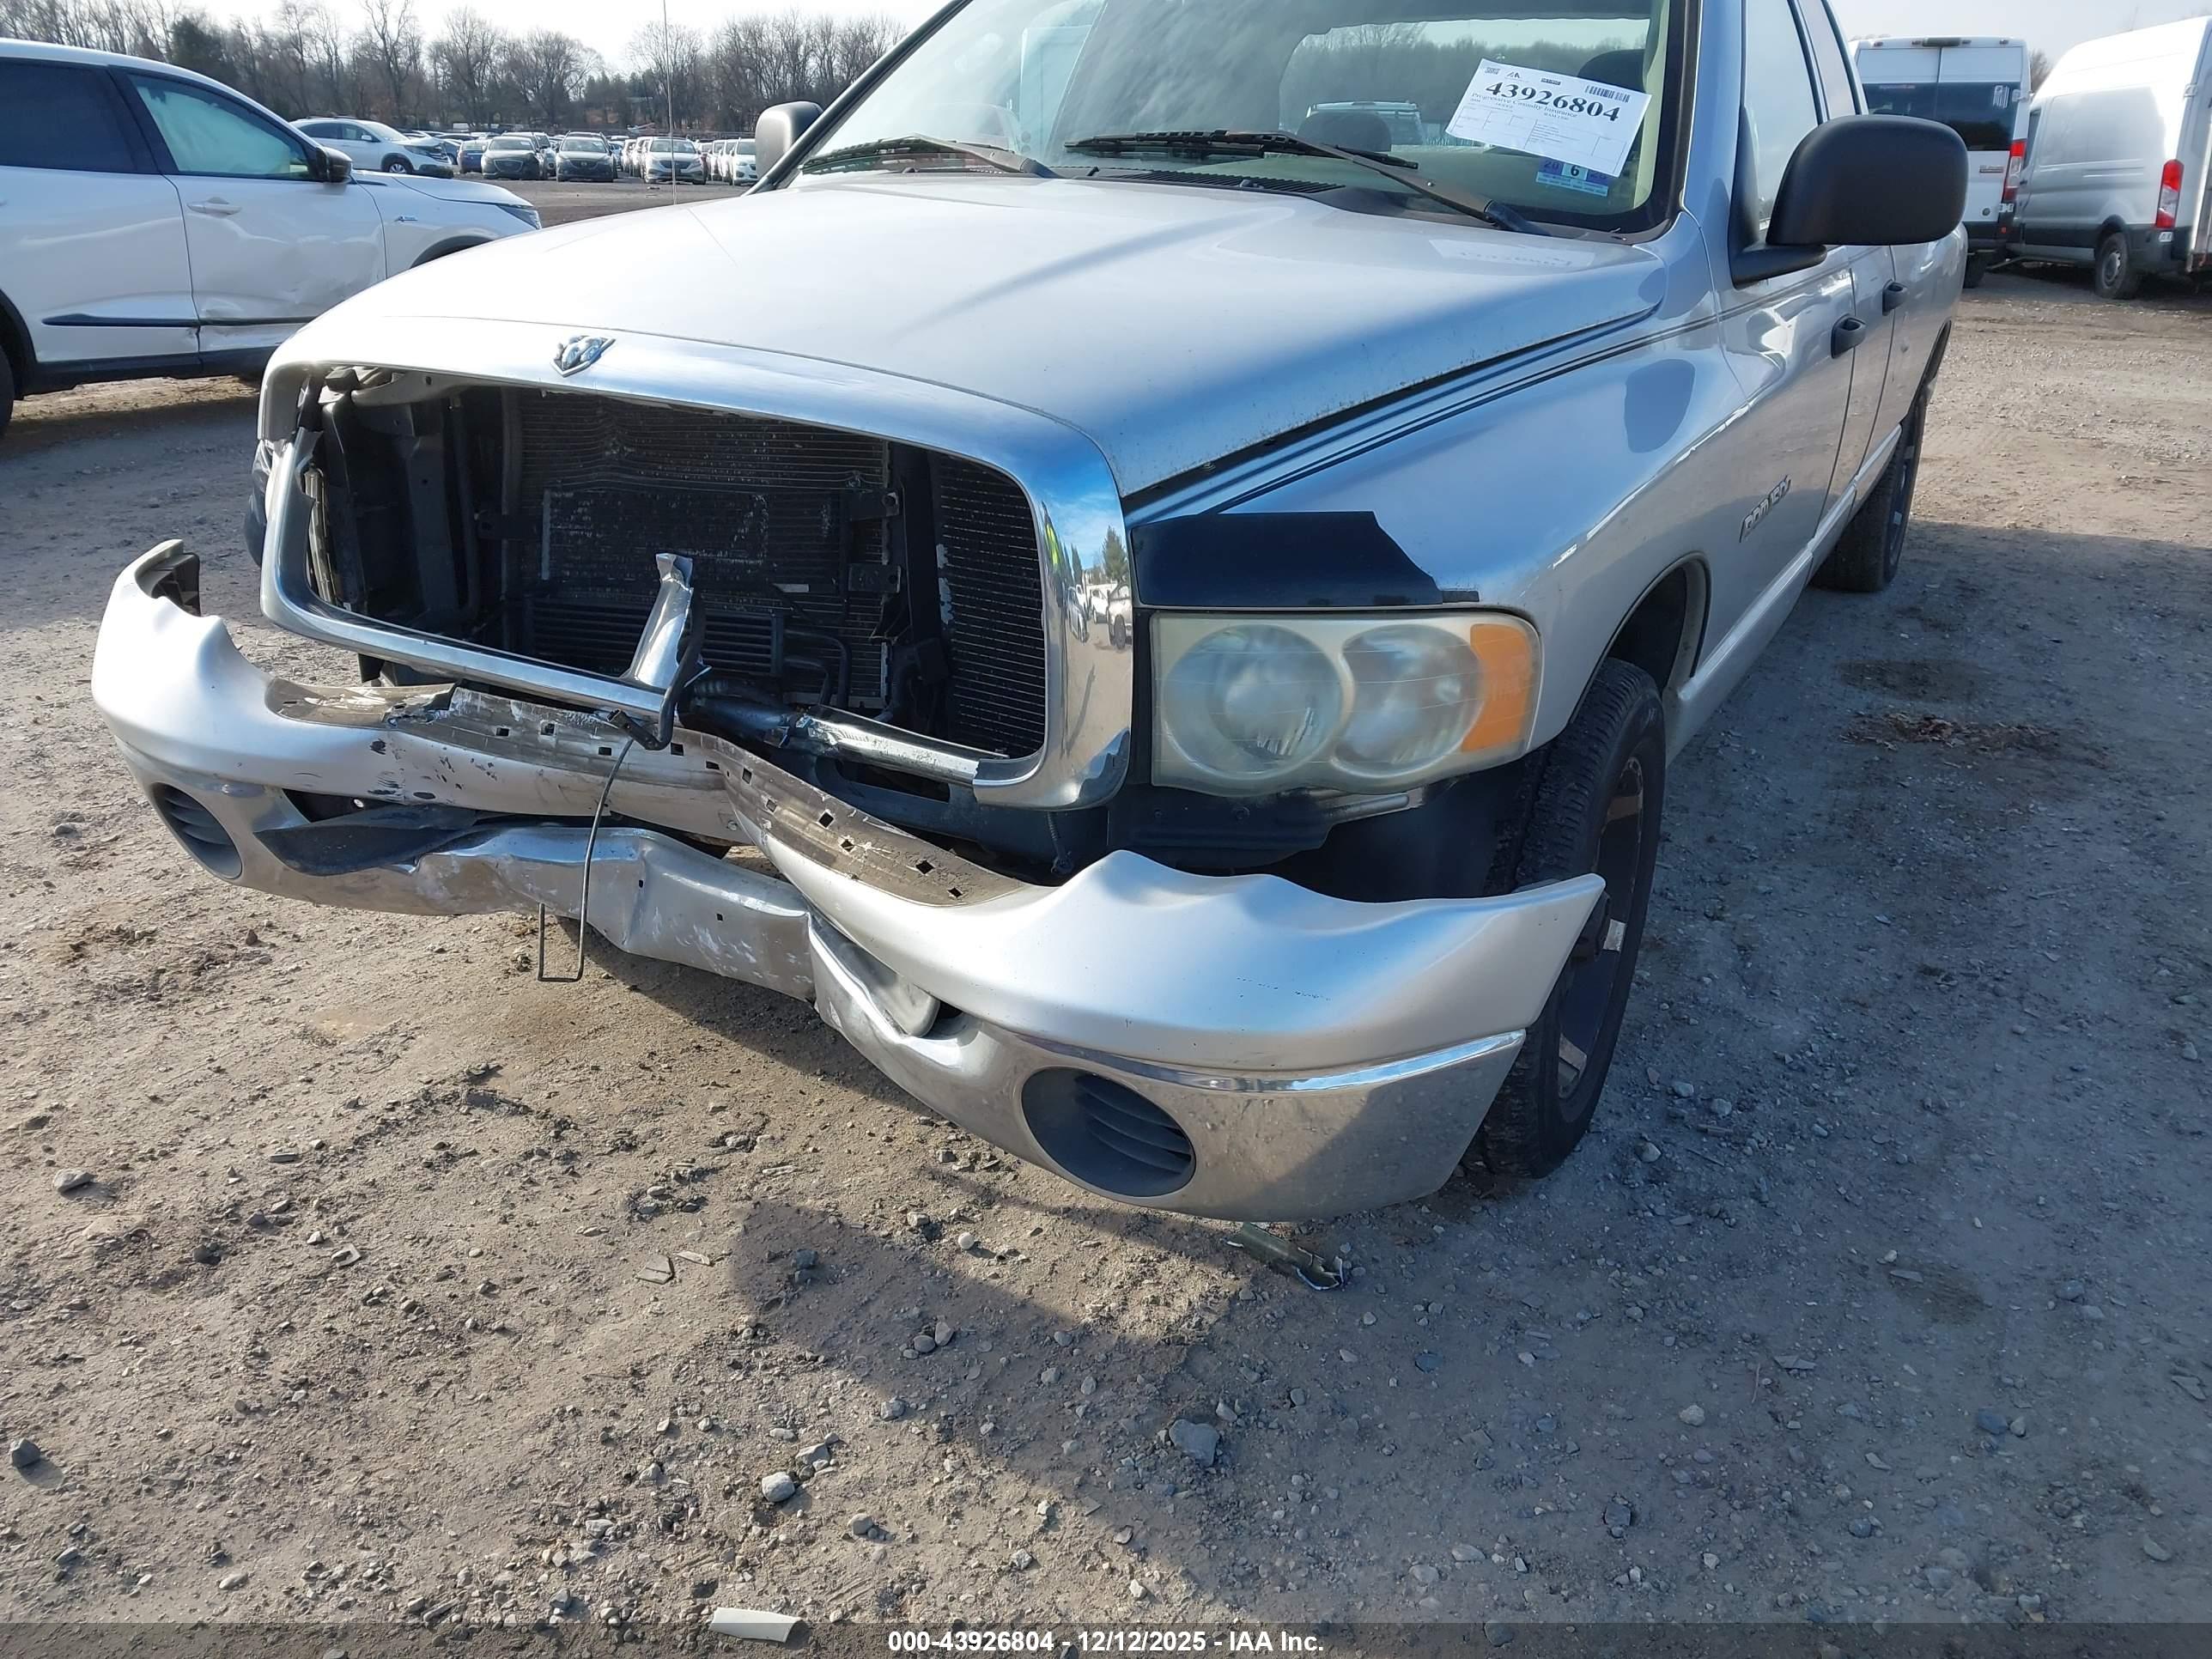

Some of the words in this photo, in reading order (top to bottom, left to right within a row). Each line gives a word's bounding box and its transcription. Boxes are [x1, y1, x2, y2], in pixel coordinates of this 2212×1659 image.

[1472, 92, 1512, 104] Progressive
[1512, 99, 1541, 111] Casualty
[1543, 106, 1577, 118] Insurance
[1486, 82, 1621, 122] 43926804
[1571, 164, 1580, 177] 6
